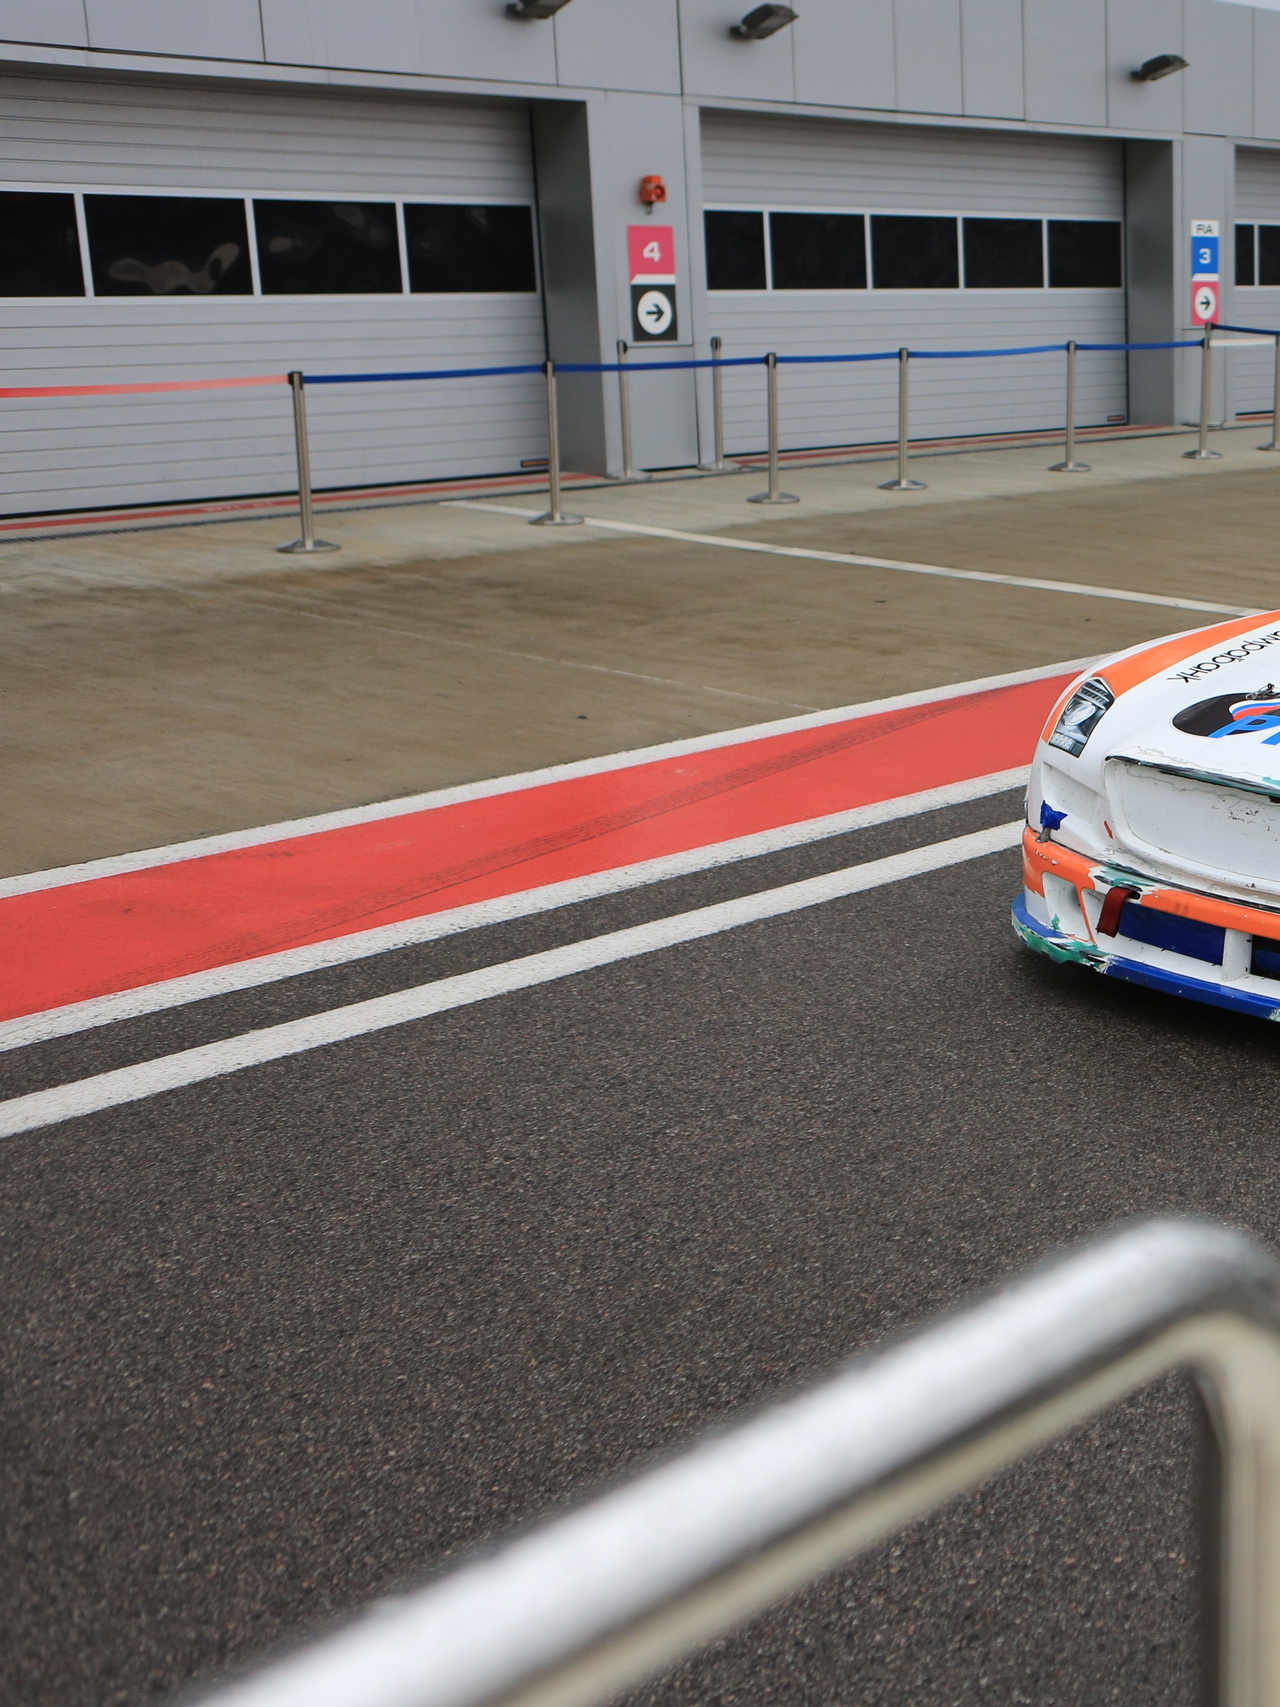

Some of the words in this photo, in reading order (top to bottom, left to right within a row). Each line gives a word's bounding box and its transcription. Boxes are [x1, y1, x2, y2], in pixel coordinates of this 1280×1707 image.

[1196, 224, 1214, 234] FIA
[643, 241, 661, 262] 4
[1199, 248, 1211, 264] 3
